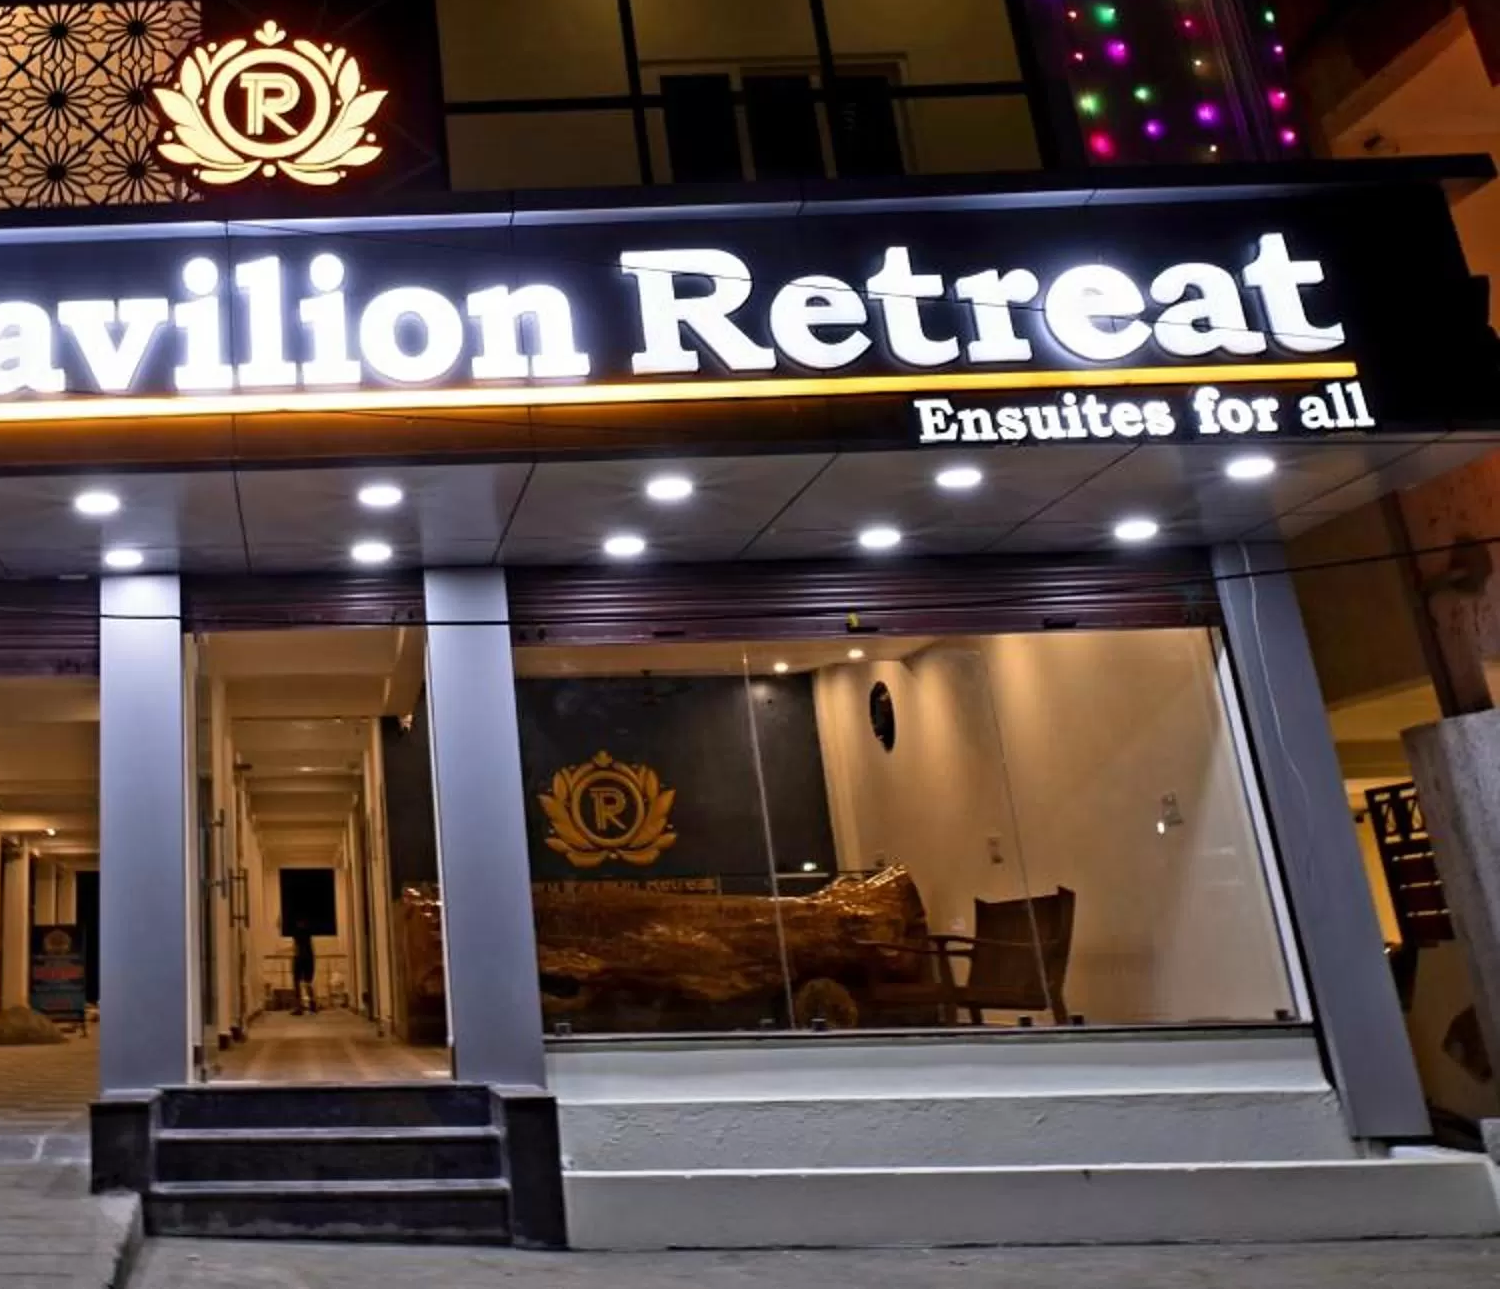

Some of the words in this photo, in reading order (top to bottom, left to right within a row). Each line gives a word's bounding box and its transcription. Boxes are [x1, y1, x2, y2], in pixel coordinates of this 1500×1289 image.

[619, 232, 1347, 375] Retreat
[913, 392, 1177, 444] Ensuites
[1192, 386, 1280, 435] for
[1299, 380, 1376, 430] all
